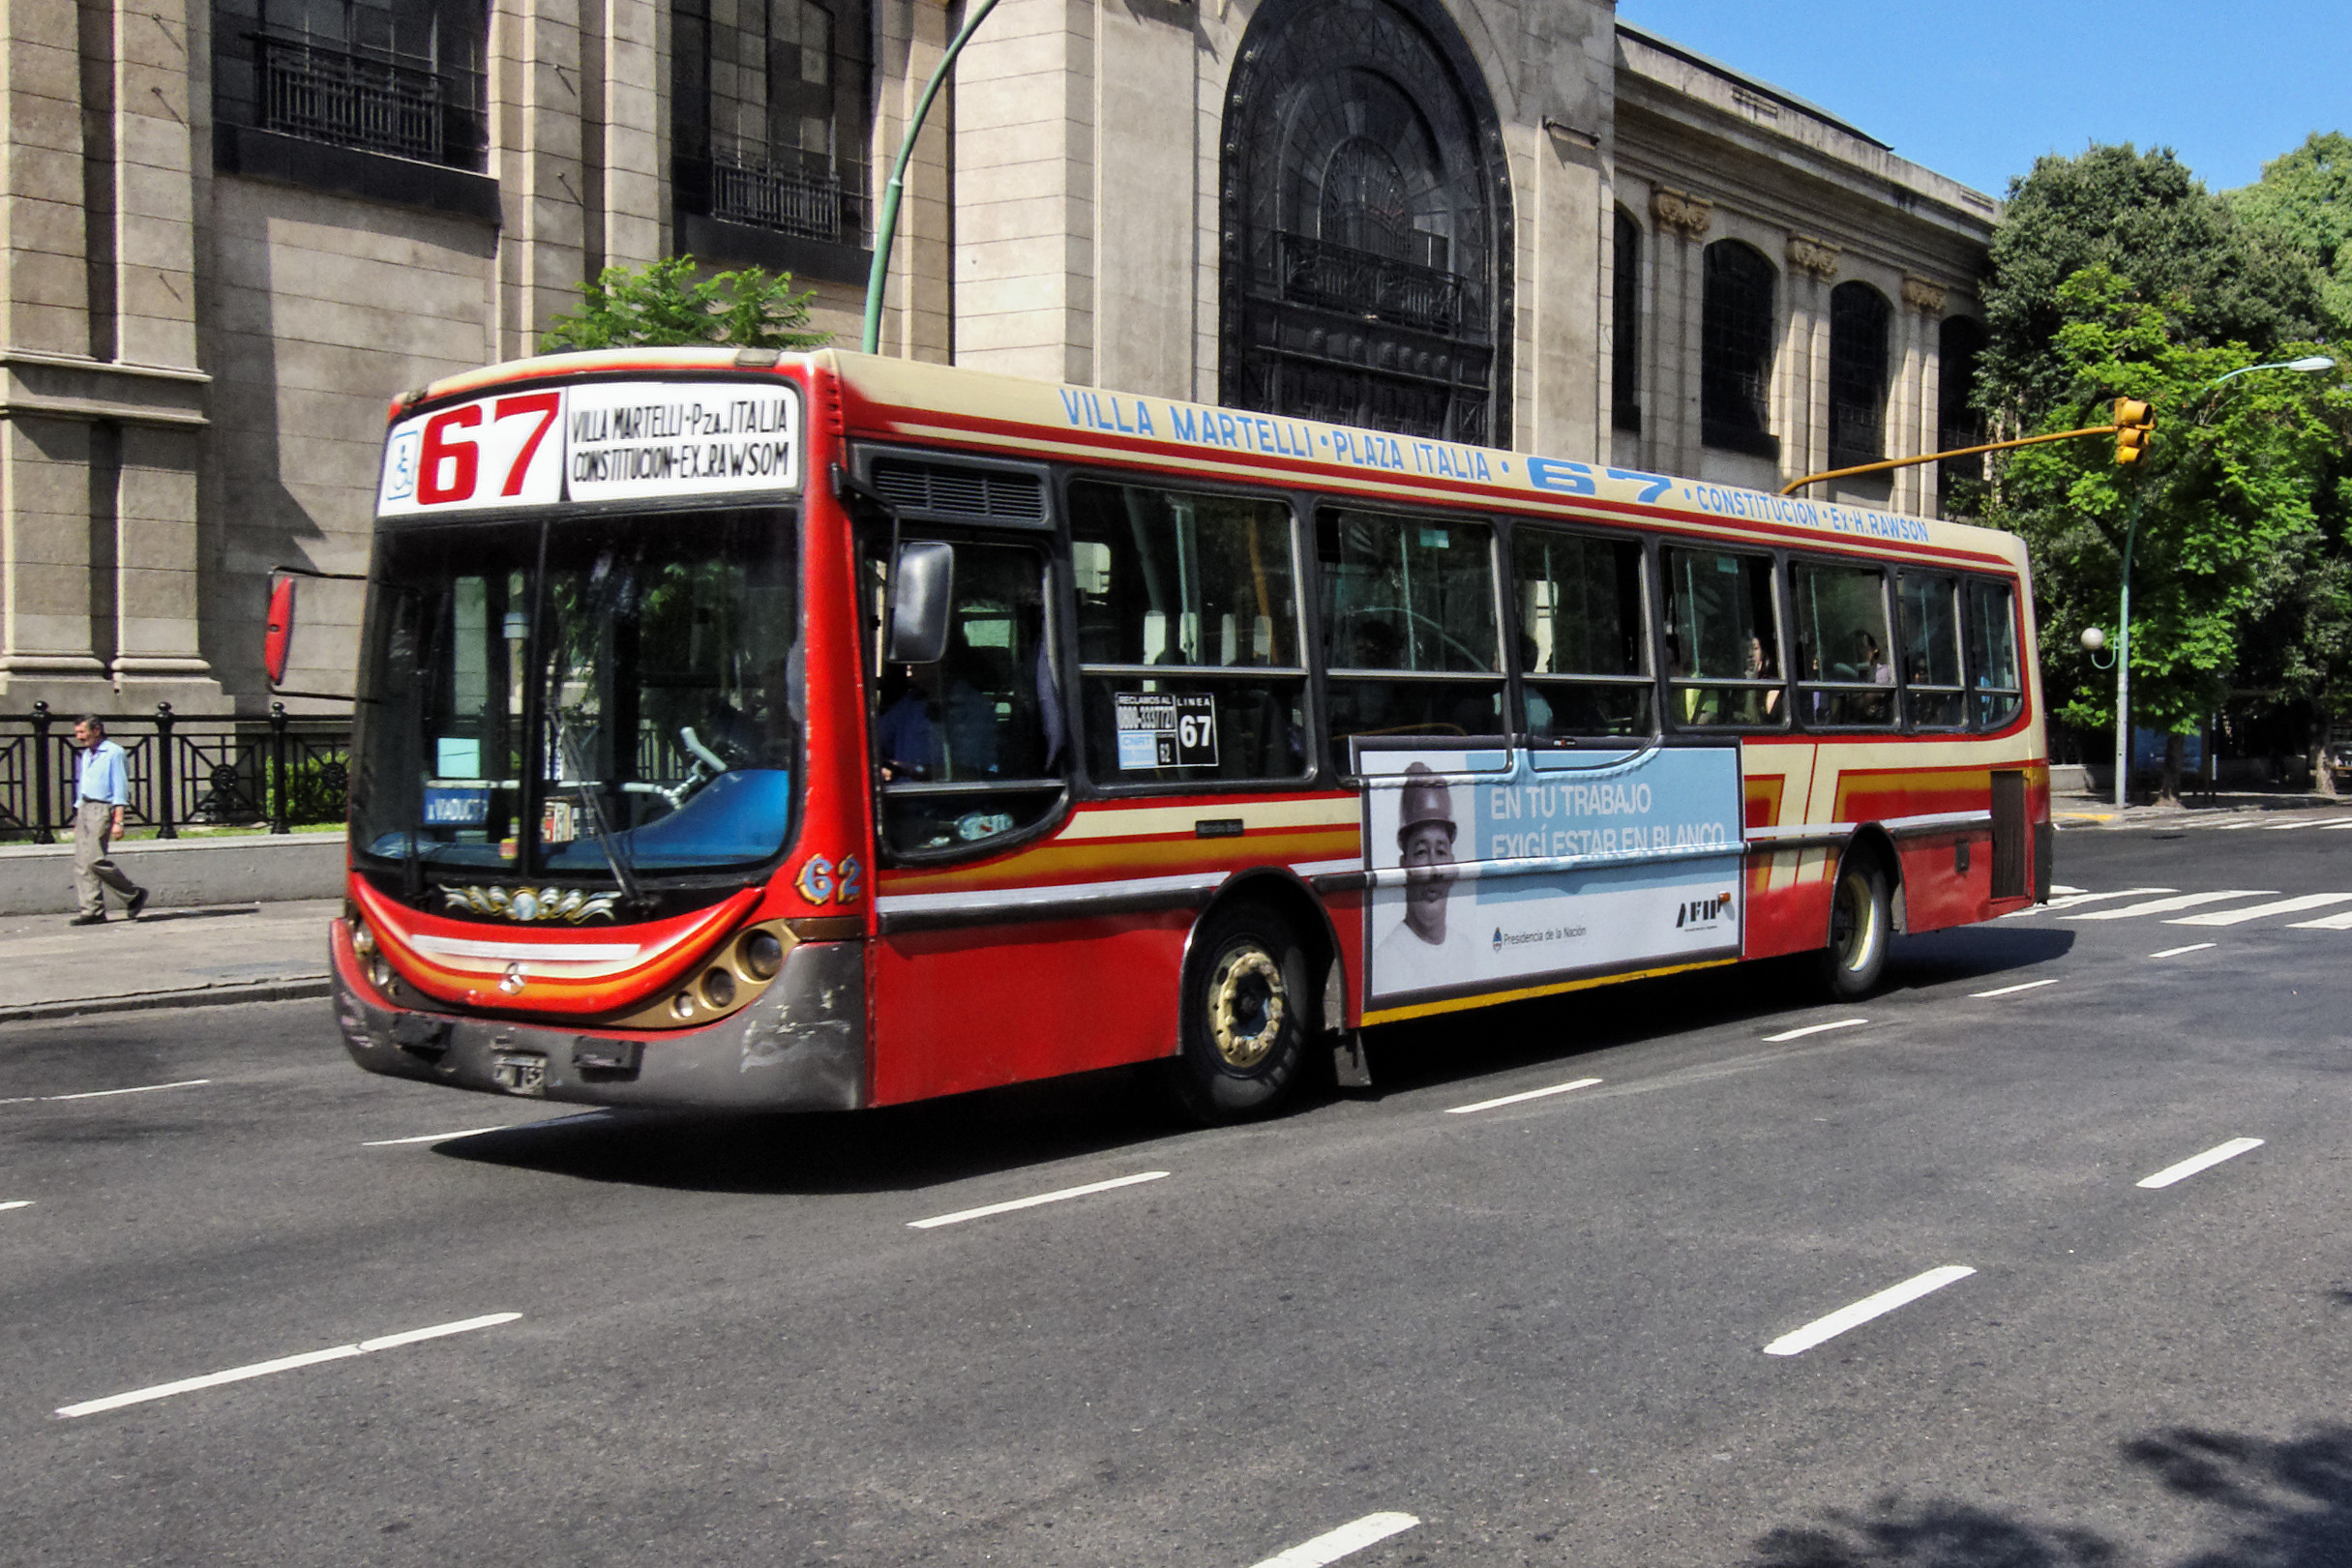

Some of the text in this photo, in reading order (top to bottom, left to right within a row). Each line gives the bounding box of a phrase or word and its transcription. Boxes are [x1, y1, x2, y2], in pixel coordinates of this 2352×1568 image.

[573, 409, 608, 443] VILLA
[417, 392, 561, 505] 67
[1059, 389, 1154, 437] VILLA
[1170, 405, 1313, 459] MARTELLI
[1333, 430, 1404, 471] PLAZA
[1413, 442, 1493, 482] ITALIA
[1527, 457, 1672, 503] 67
[1697, 487, 1819, 528] CONSTITUCION
[1176, 697, 1211, 707] LINEA
[1180, 715, 1211, 748] 67
[1491, 783, 1652, 820] EN TU TRABAJO
[1492, 822, 1726, 859] EXIGÍ ESTAR EN BLANCO
[795, 853, 863, 905] 62
[1503, 926, 1587, 946] Presidencia de la Nación
